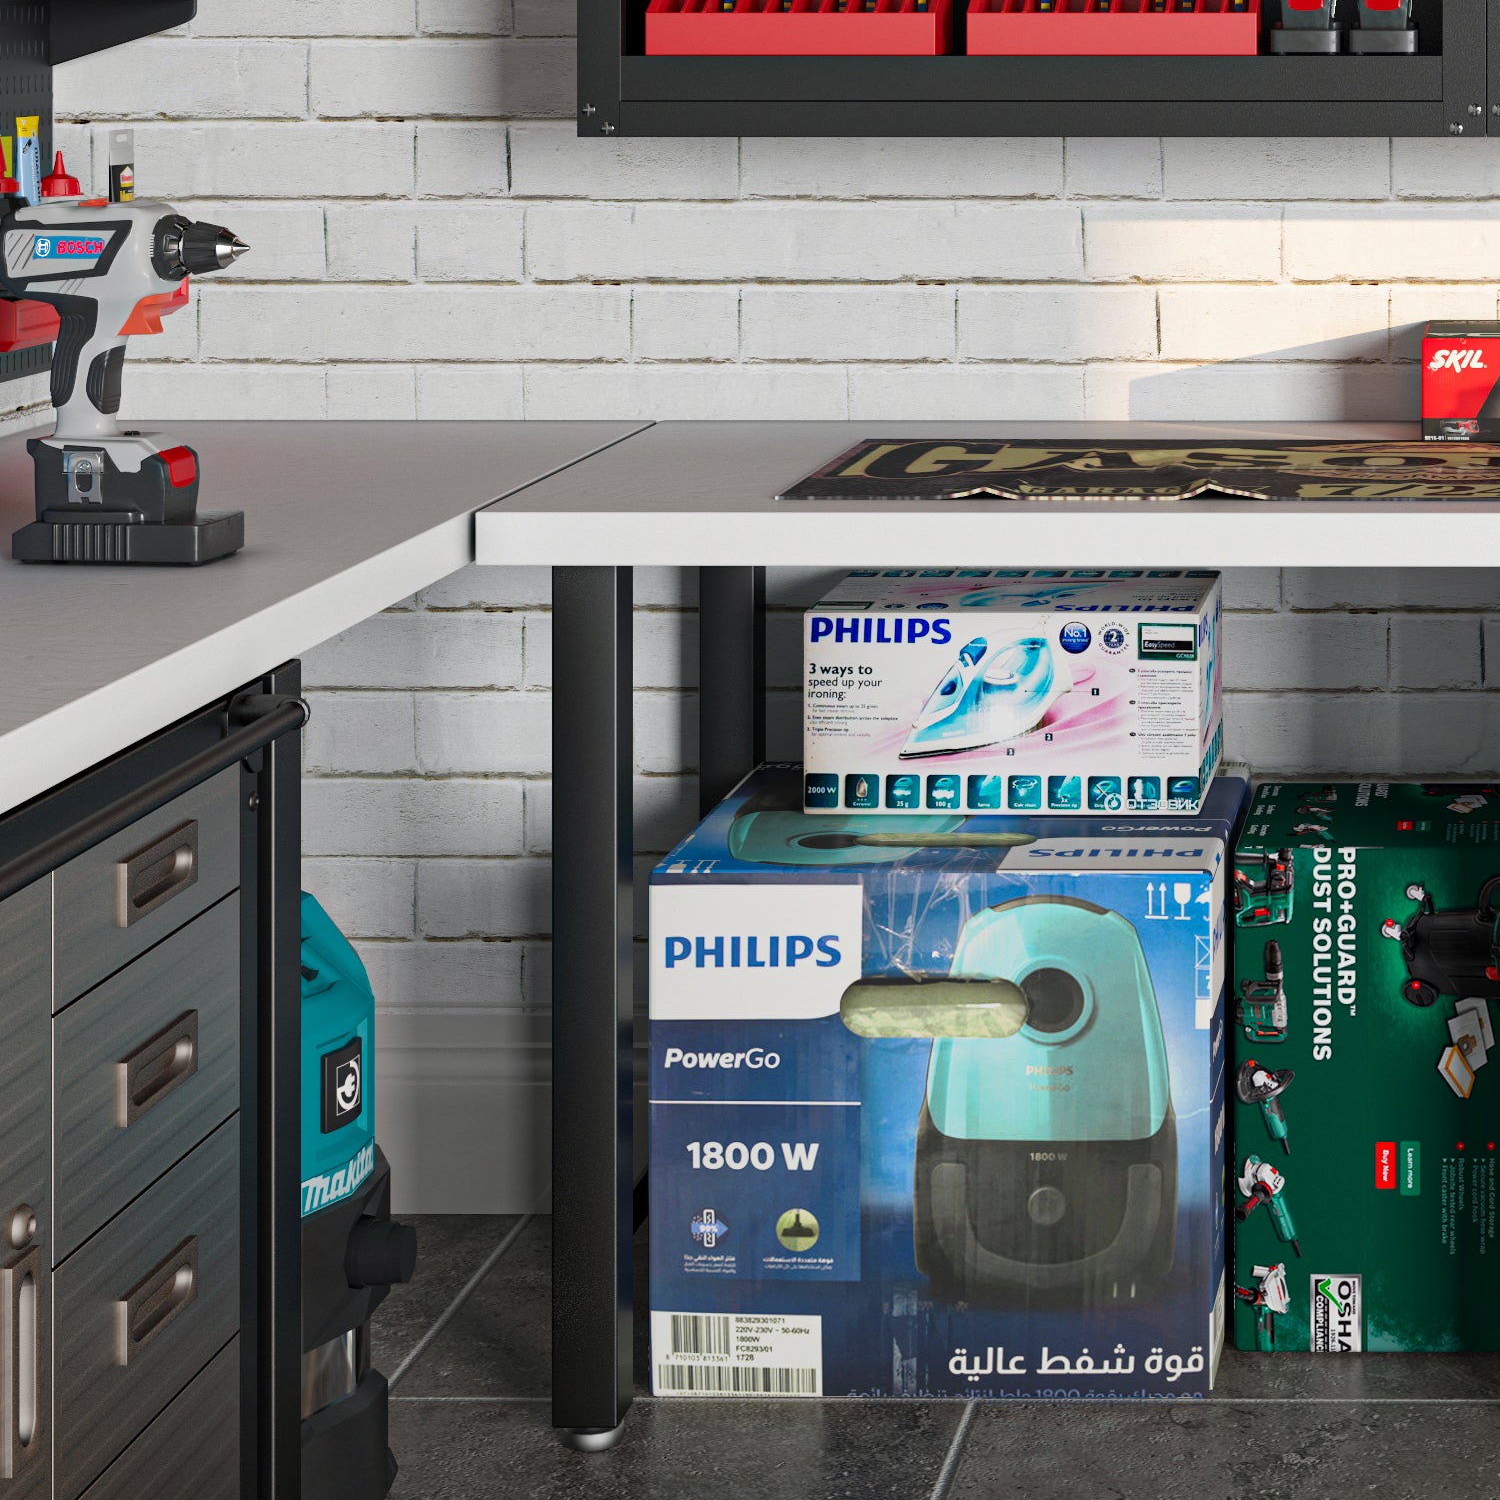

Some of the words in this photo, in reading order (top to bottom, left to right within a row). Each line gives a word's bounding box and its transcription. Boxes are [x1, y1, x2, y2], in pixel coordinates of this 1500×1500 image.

[56, 239, 103, 256] BOSCH
[1430, 349, 1486, 373] SKIL
[811, 616, 952, 645] PHILIPS
[809, 663, 817, 674] 3
[820, 665, 854, 678] ways
[858, 664, 873, 675] to
[807, 689, 847, 702] ironing:
[808, 677, 838, 689] speed
[841, 679, 855, 689] up
[858, 679, 883, 690] your
[807, 786, 826, 794] 2000
[1312, 844, 1332, 912] DUST
[664, 935, 842, 970] PHILIPS
[1312, 917, 1332, 1061] SOLUTIONS
[664, 1047, 781, 1070] PowerGo
[685, 1140, 775, 1171] 1800
[781, 1141, 820, 1171] W
[1029, 1152, 1055, 1162] 1800
[1057, 1152, 1068, 1162] W
[1381, 1149, 1389, 1164] Buy
[1407, 1147, 1415, 1169] Learn
[1315, 1294, 1325, 1352] COMPLIANC
[948, 1346, 1027, 1382] عالية
[1036, 1343, 1135, 1375] شفط
[1143, 1345, 1204, 1382] قوة
